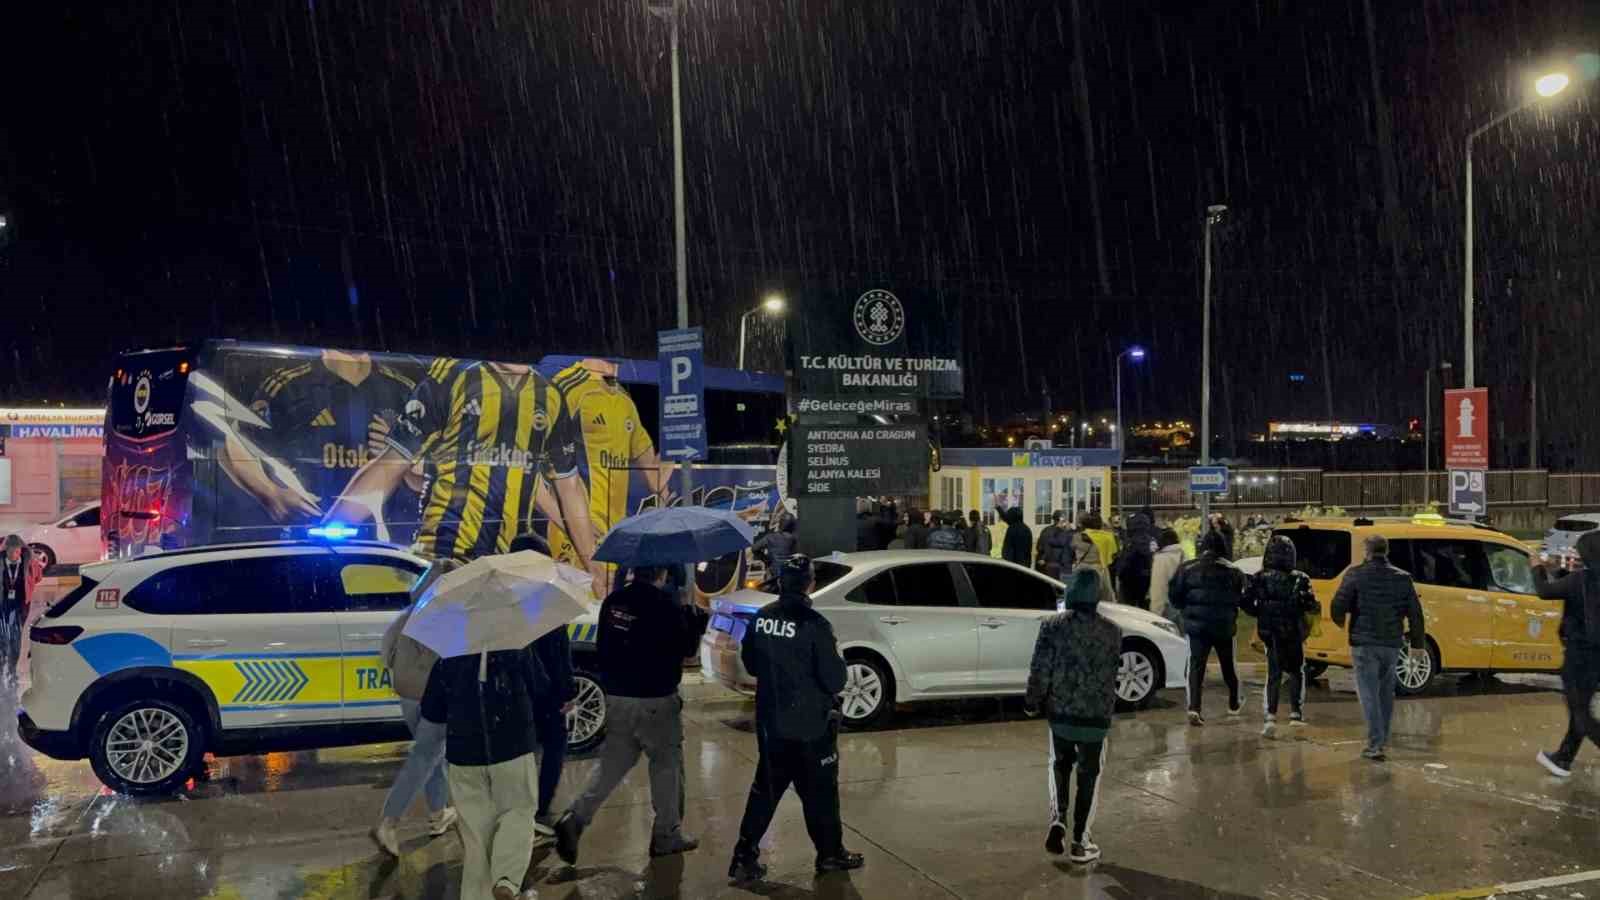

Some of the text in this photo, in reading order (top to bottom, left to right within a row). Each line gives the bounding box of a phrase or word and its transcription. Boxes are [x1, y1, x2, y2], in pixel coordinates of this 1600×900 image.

[800, 355, 957, 371] T.C. KÜLTÜR VE TURİZM
[843, 372, 918, 386] BAKANLIĞI
[799, 400, 911, 413] #GeleceğeMiras
[861, 430, 874, 440] AD
[807, 444, 845, 453] SYEDRA
[807, 470, 846, 480] ALANYA
[356, 668, 393, 689] TRA
